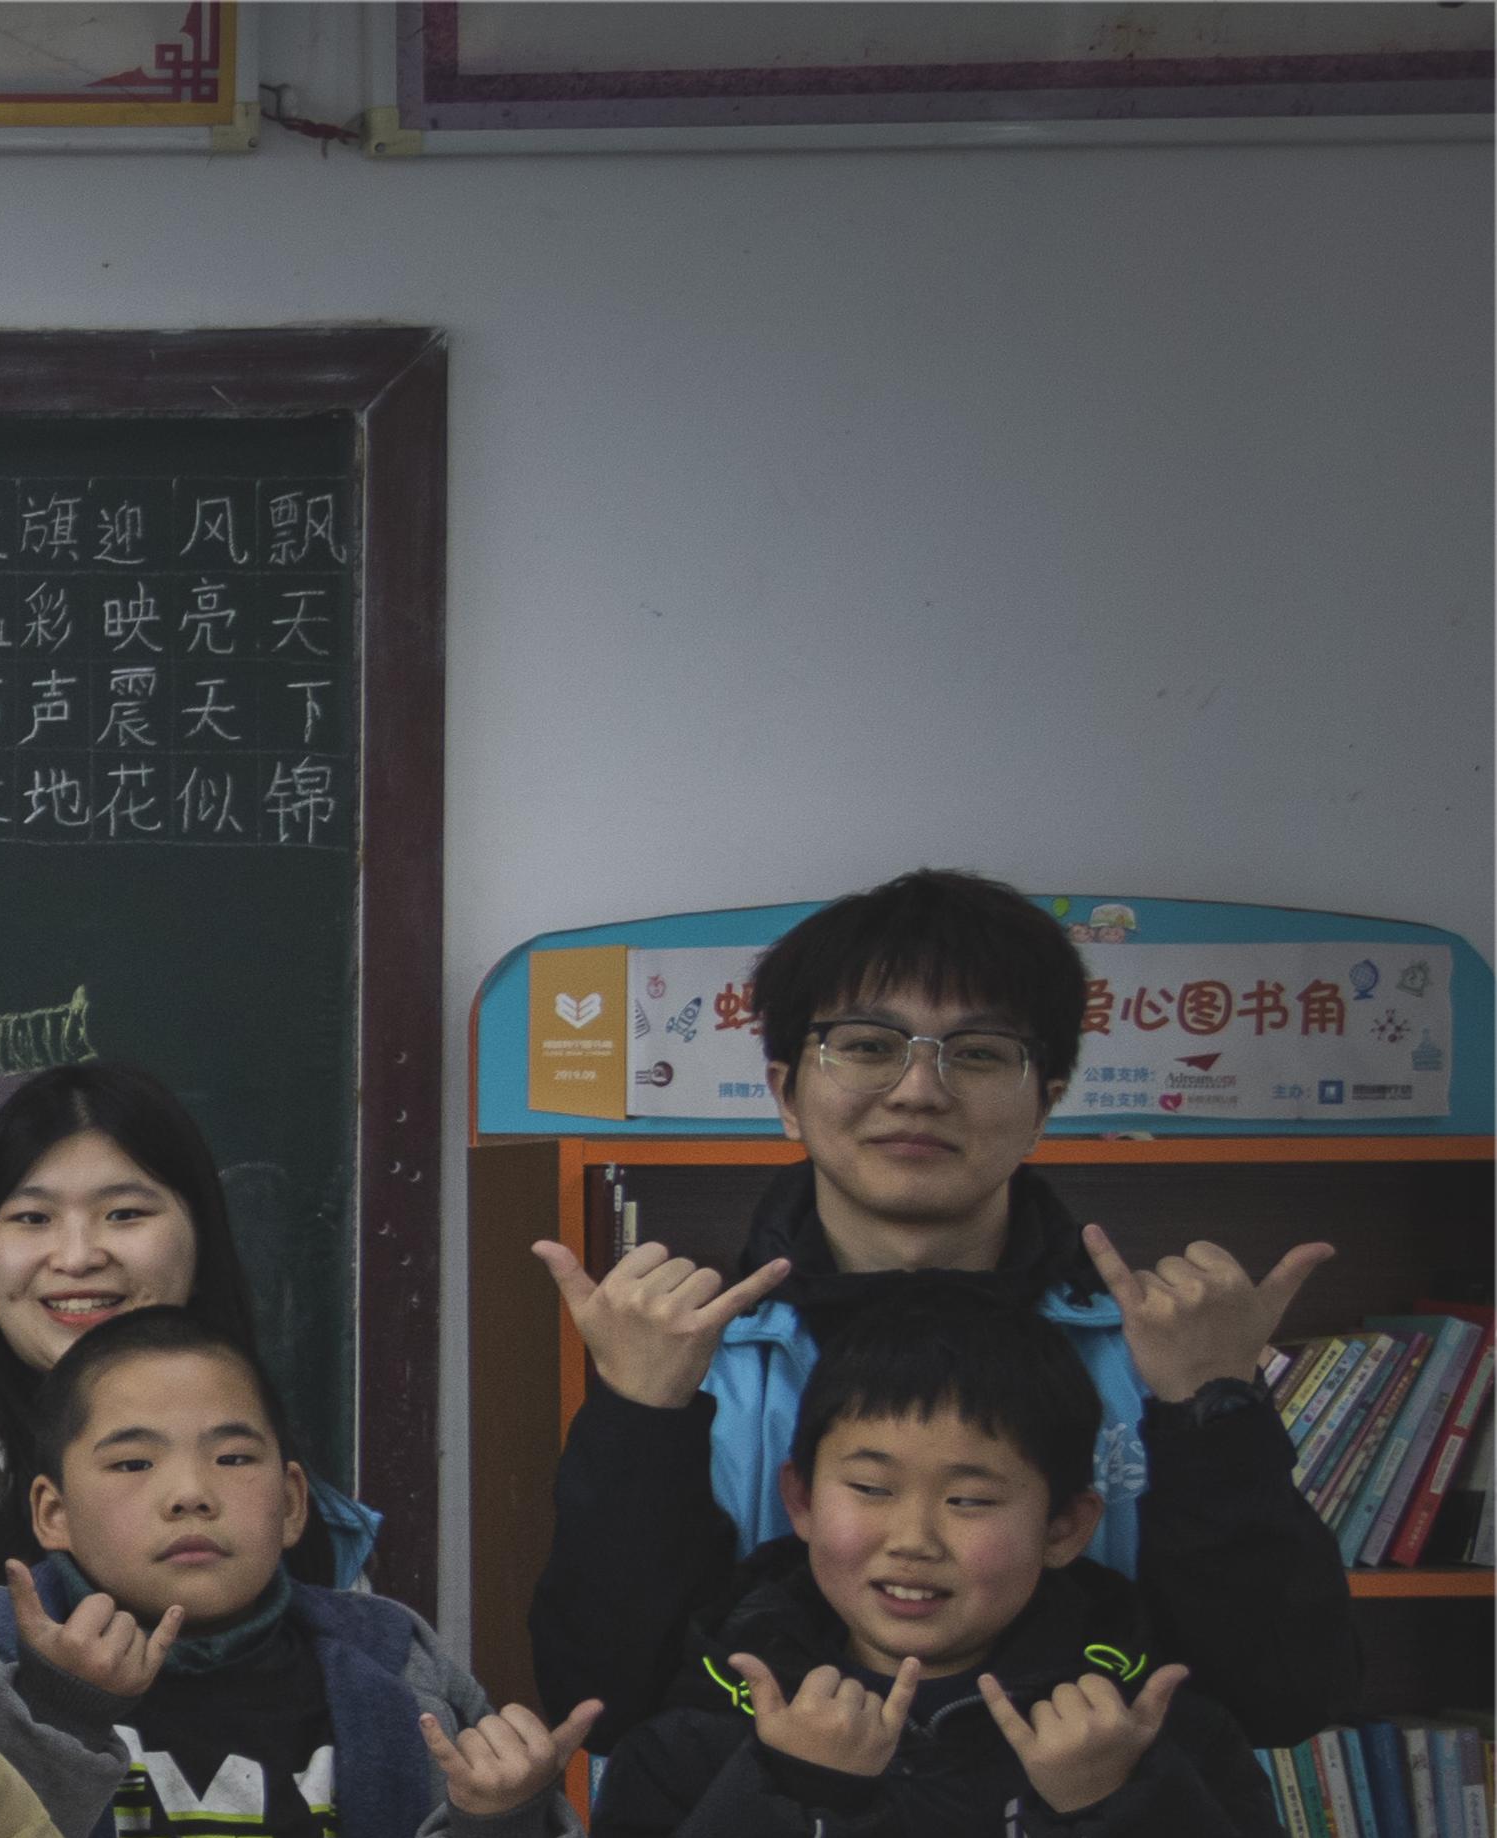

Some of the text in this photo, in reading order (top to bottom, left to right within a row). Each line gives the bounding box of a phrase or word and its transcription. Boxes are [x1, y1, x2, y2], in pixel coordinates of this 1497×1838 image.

[1080, 977, 1348, 1037] 爱心图书角
